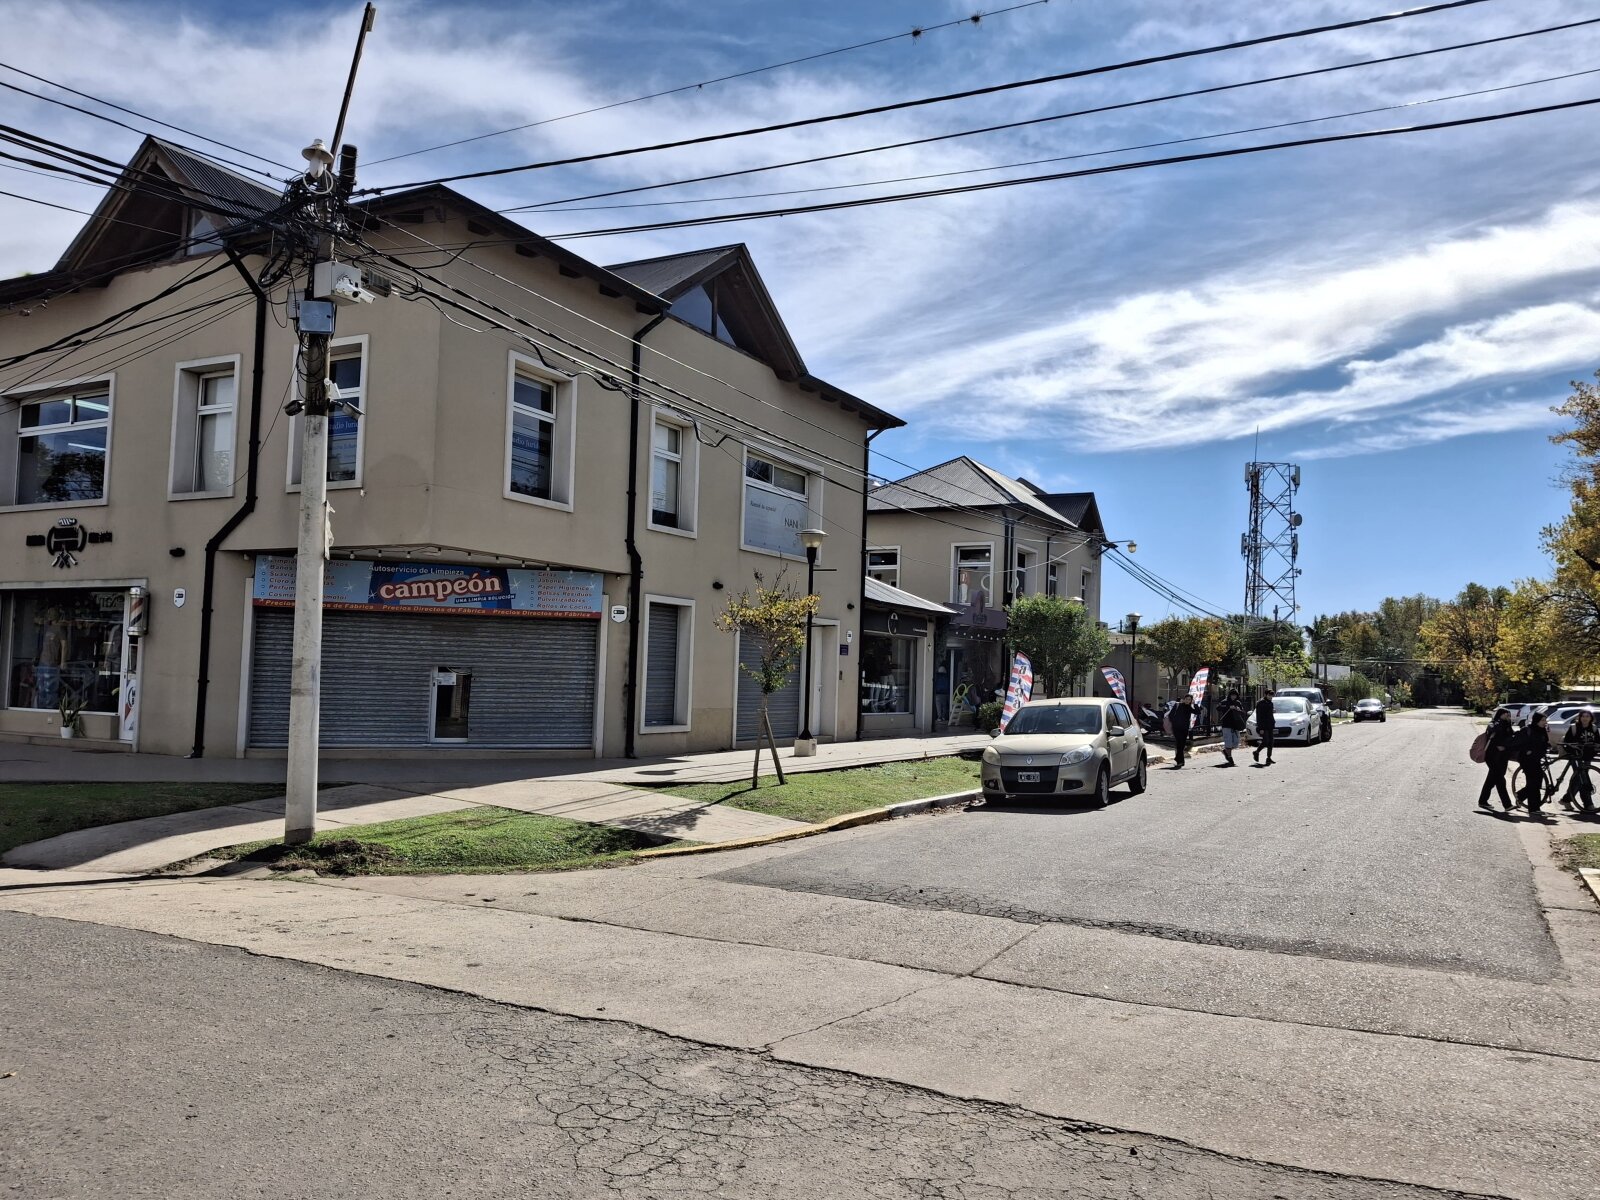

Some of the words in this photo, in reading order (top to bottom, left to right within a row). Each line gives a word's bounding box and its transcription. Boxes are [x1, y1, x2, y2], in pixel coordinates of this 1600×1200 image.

[368, 564, 418, 574] Autoservicio
[418, 566, 429, 574] de
[430, 566, 465, 576] Limpieza
[380, 573, 501, 600] campeón
[457, 606, 486, 614] Fábrica
